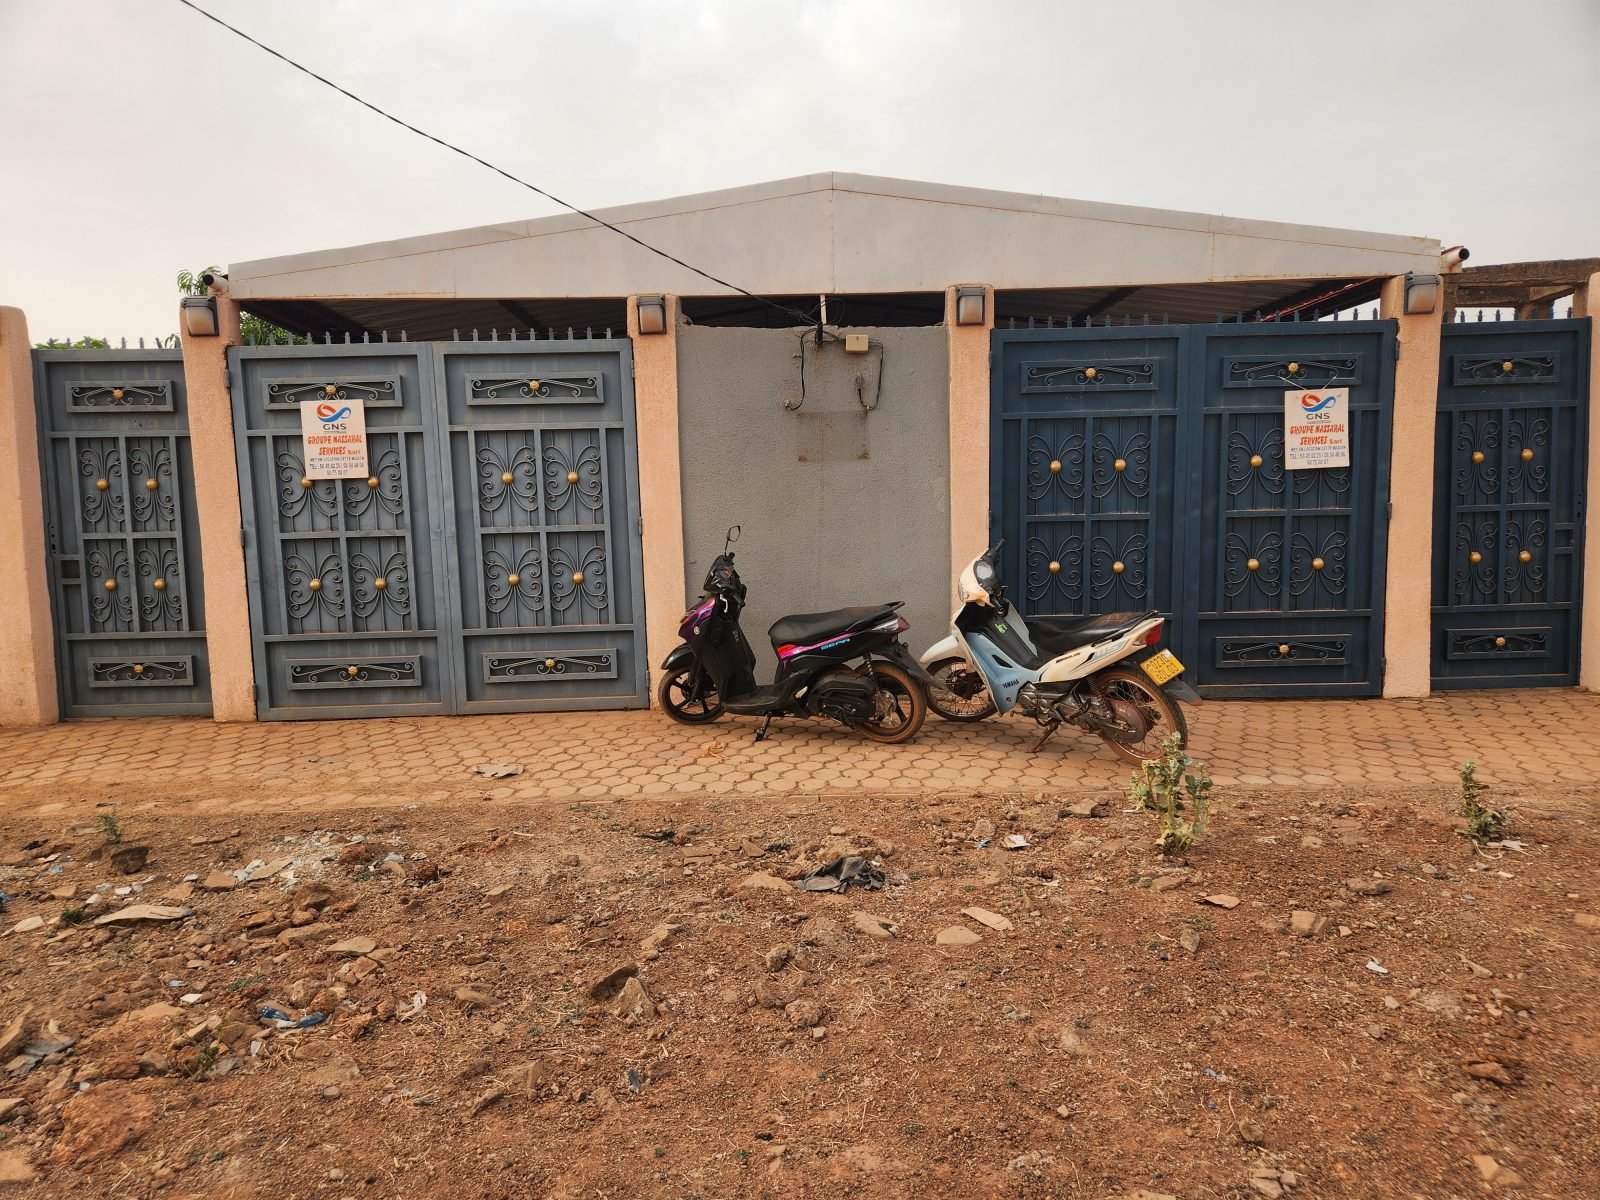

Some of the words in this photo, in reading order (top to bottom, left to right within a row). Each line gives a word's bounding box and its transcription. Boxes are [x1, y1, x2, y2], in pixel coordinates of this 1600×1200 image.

[1290, 425, 1314, 434] GROUPE
[308, 436, 331, 444] GROUPE
[1300, 436, 1327, 445] SERVICES
[319, 447, 346, 455] SERVICES
[1150, 654, 1169, 670] 0230
[1002, 679, 1019, 688] YAMAHA
